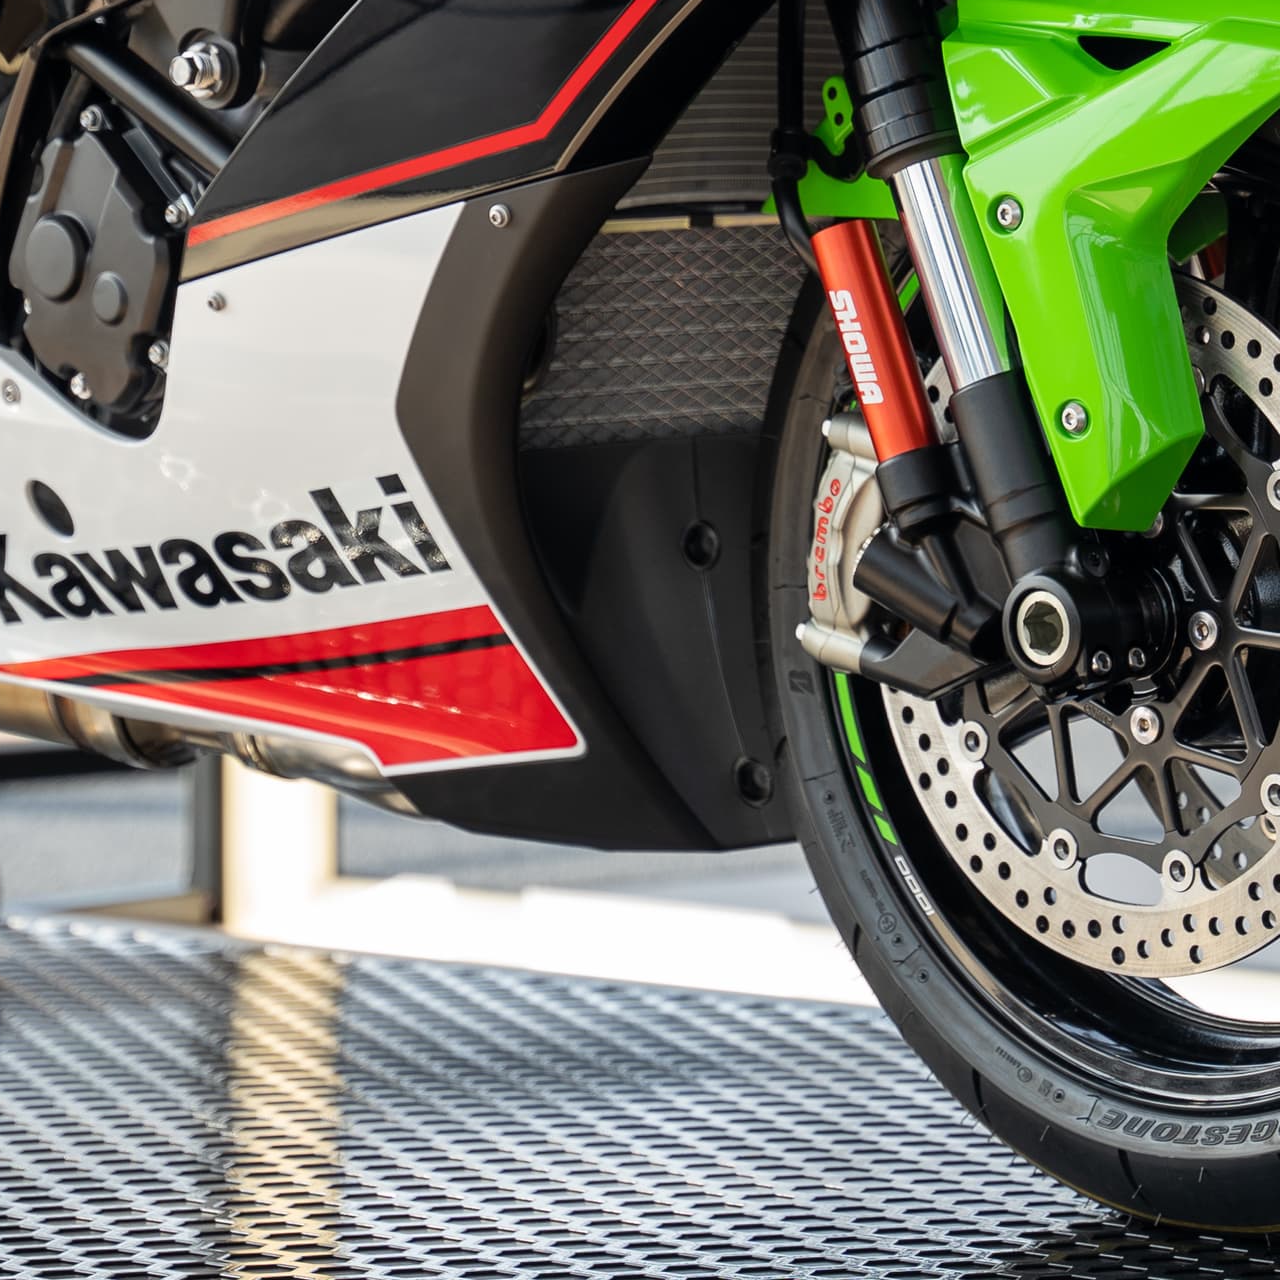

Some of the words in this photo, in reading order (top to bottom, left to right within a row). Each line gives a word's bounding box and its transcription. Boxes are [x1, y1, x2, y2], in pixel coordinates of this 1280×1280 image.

[828, 288, 885, 406] SHOWA
[812, 478, 842, 602] brembo
[894, 855, 935, 916] 1000
